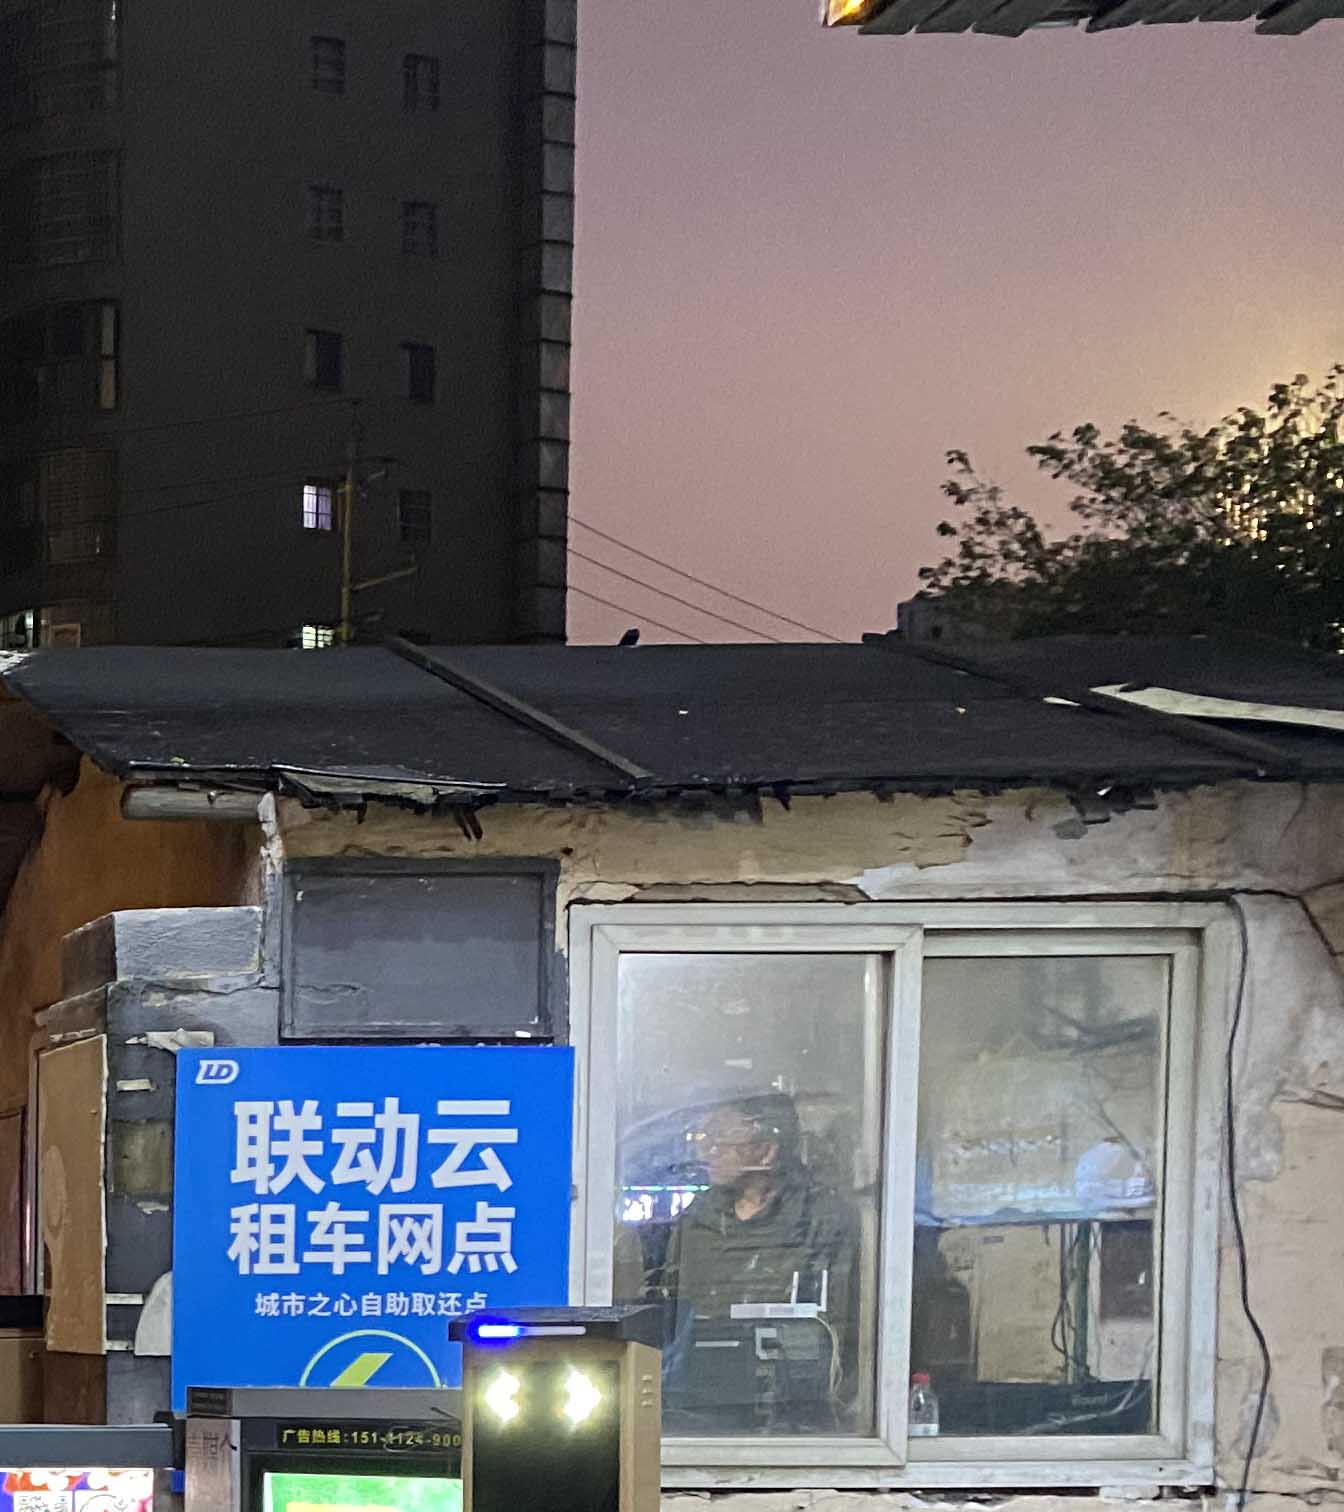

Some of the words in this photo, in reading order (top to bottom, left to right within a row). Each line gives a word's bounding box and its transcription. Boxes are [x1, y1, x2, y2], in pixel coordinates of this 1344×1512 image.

[230, 1097, 518, 1195] 联动云
[227, 1202, 519, 1275] 租车网点
[255, 1292, 488, 1317] 城市之心自助取还点
